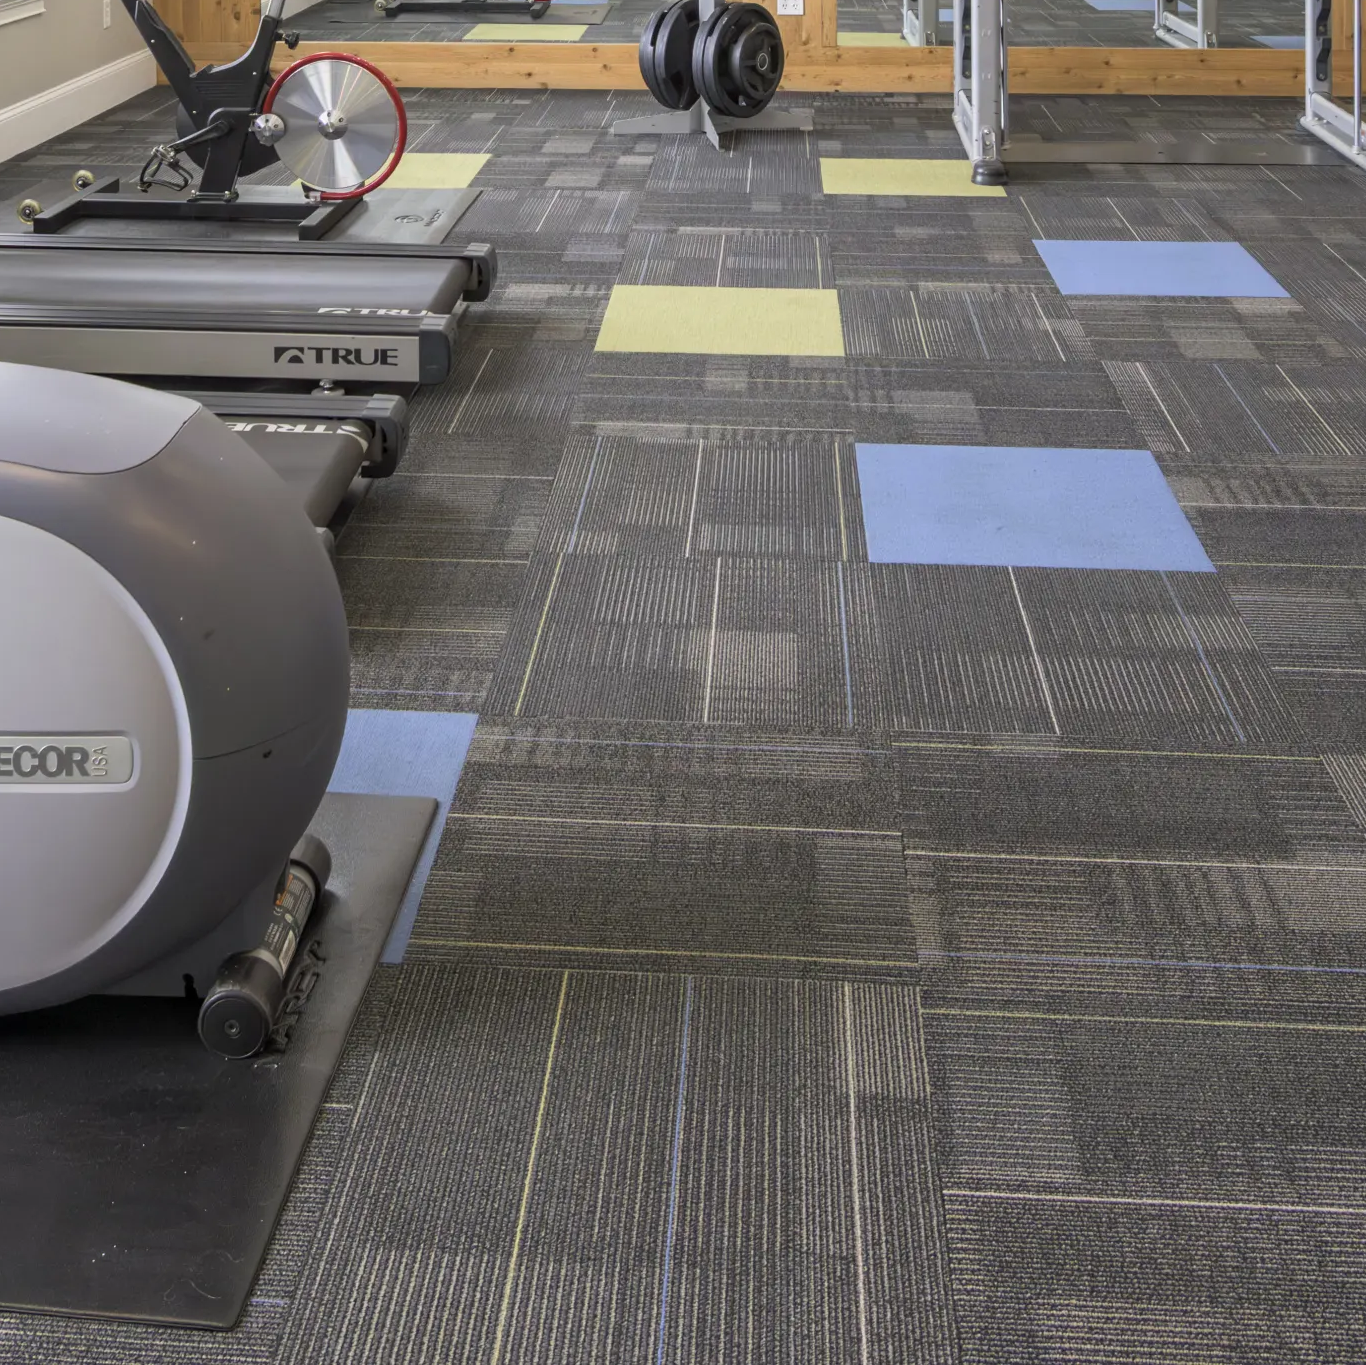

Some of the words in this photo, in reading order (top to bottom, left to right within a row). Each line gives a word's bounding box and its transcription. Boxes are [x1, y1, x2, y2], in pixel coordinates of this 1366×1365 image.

[354, 307, 434, 317] TRU
[307, 346, 399, 367] TRUE
[224, 421, 334, 435] TRUE
[91, 745, 108, 777] USA
